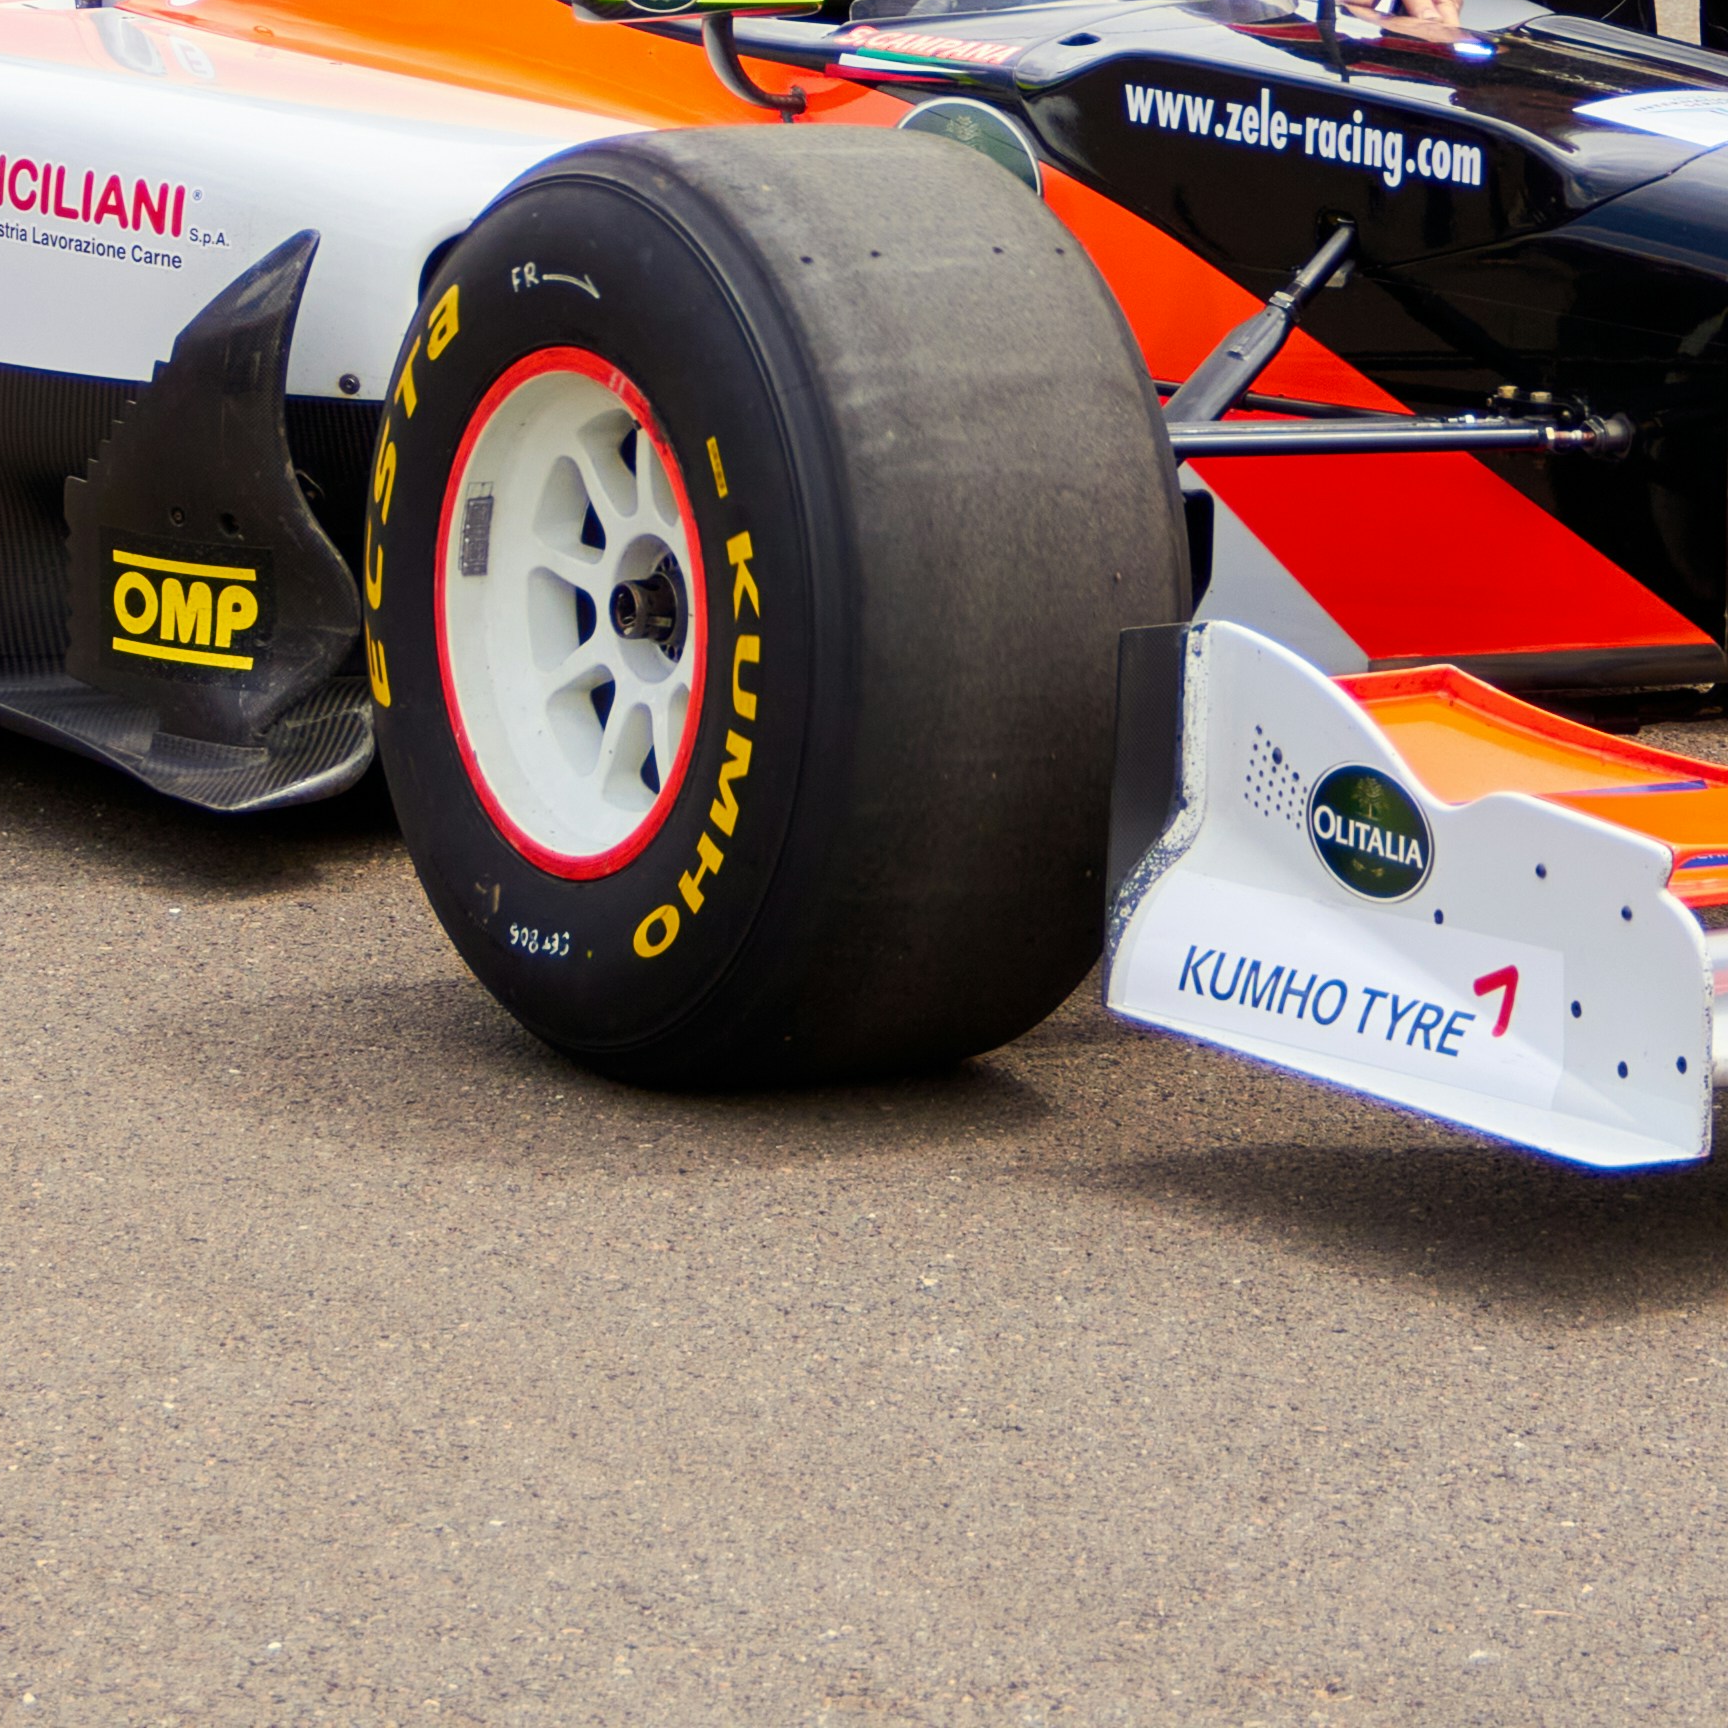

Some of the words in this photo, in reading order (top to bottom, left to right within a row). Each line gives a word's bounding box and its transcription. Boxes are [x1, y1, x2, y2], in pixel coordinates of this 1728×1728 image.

[1125, 83, 1481, 187] www.zele-racing.com
[31, 224, 126, 260] Lavorazione
[131, 245, 182, 270] Carne
[188, 226, 230, 248] S.p.A.
[113, 571, 259, 649] OMP
[633, 531, 762, 959] KUMHO
[1313, 805, 1423, 870] OLITALIA
[1177, 945, 1346, 1026] KUMHO
[1355, 987, 1474, 1057] TYRE
